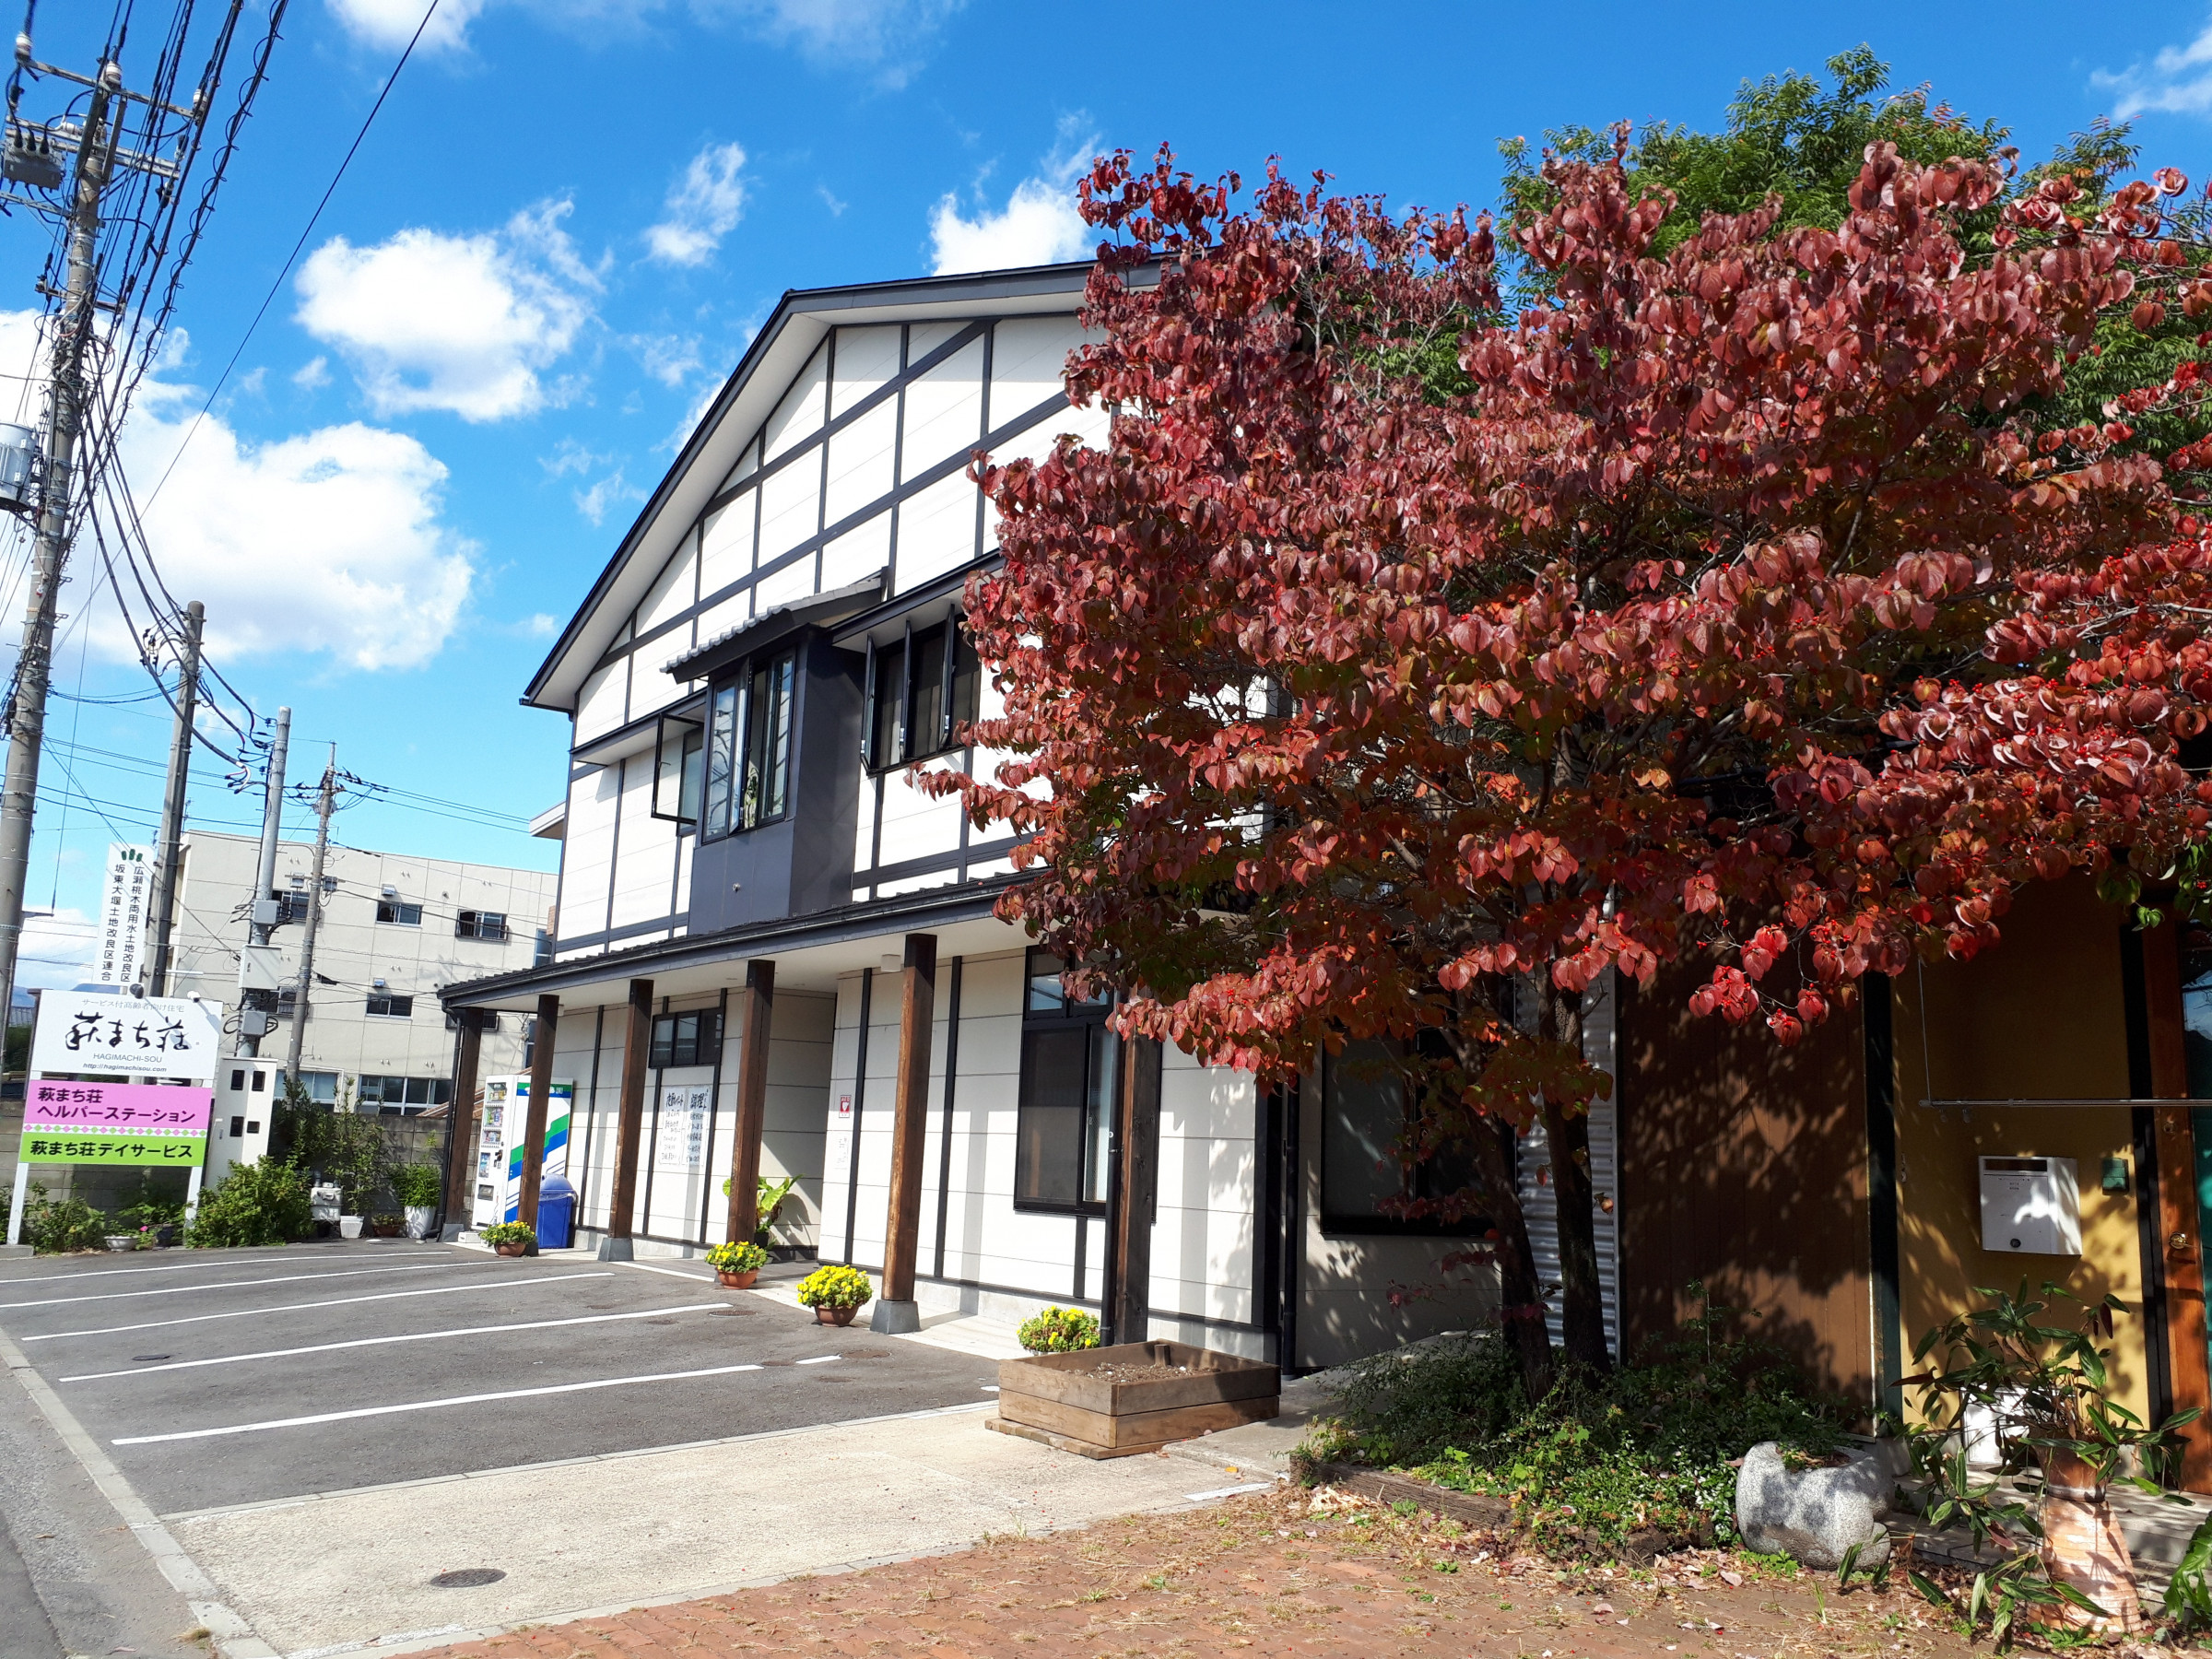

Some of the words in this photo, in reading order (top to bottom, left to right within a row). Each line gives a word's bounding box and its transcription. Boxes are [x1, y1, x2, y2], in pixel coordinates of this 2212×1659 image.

[101, 864, 125, 981] 坂東大堰土地改良区連合
[121, 866, 144, 982] 広瀬桃木両用水土地改良区
[81, 998, 184, 1013] サービス付高齢者向け住宅
[65, 1011, 191, 1053] 萩まち荘
[93, 1053, 162, 1063] HAGIMACHI-SOU
[82, 1063, 167, 1072] http://hagimachisou.com
[38, 1087, 103, 1103] 萩まち荘
[37, 1105, 195, 1123] ヘルパーステーション
[30, 1140, 193, 1158] 萩まち荘デイサービス
